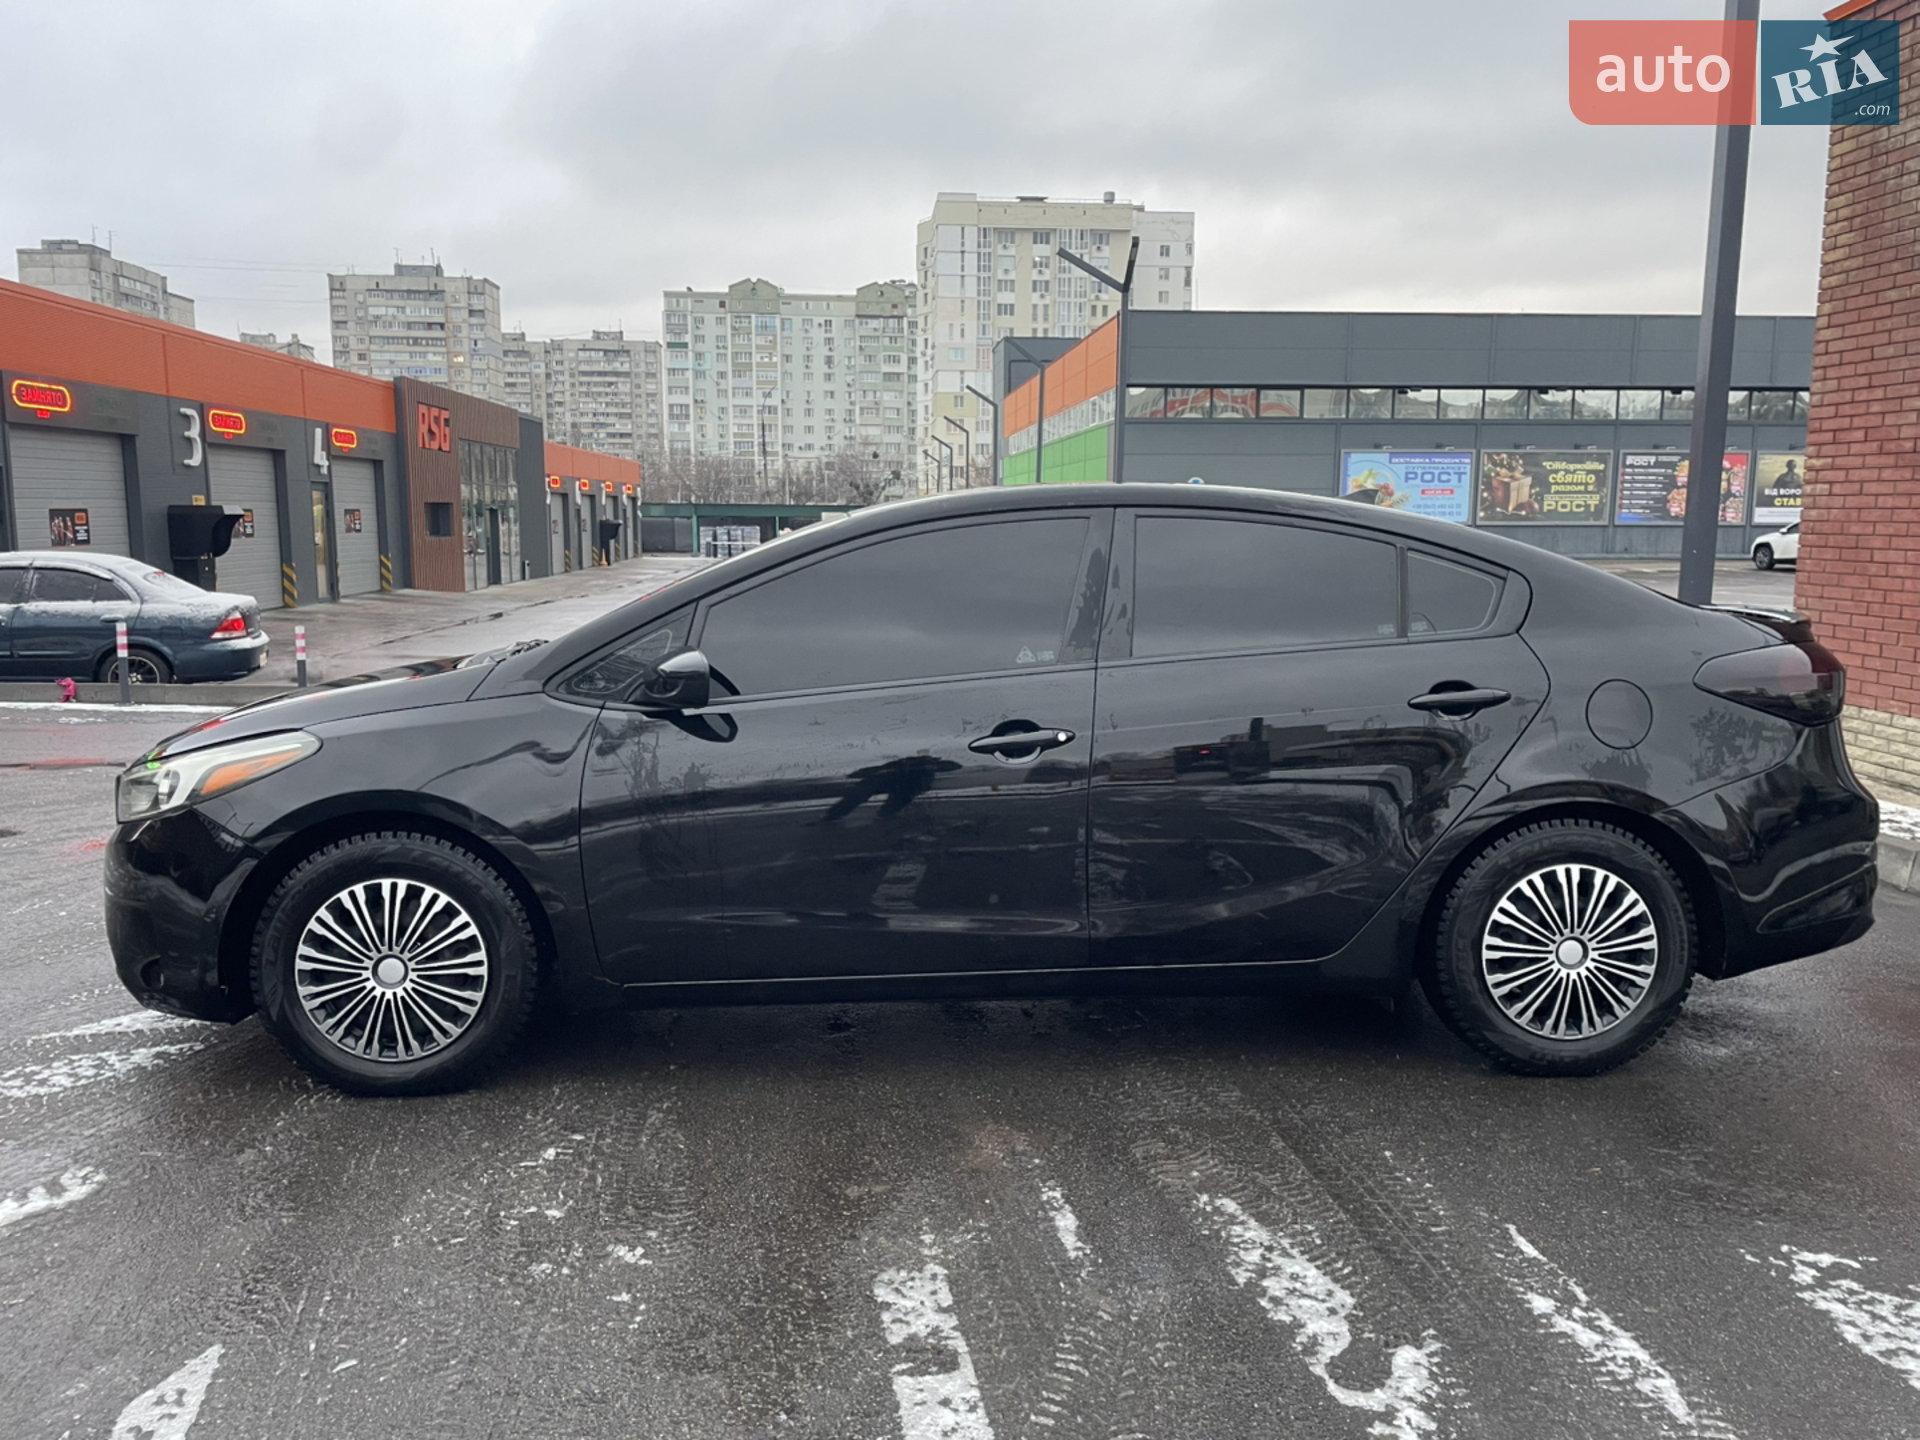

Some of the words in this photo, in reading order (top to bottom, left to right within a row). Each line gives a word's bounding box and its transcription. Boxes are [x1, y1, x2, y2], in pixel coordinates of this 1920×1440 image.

[418, 404, 450, 452] RSG
[180, 407, 202, 466] 3
[313, 428, 329, 475] 4
[1404, 471, 1467, 483] РОСТ
[1549, 471, 1595, 483] свято
[1551, 485, 1585, 493] разом
[1764, 488, 1778, 496] ВІД
[1544, 501, 1599, 512] РОСТ
